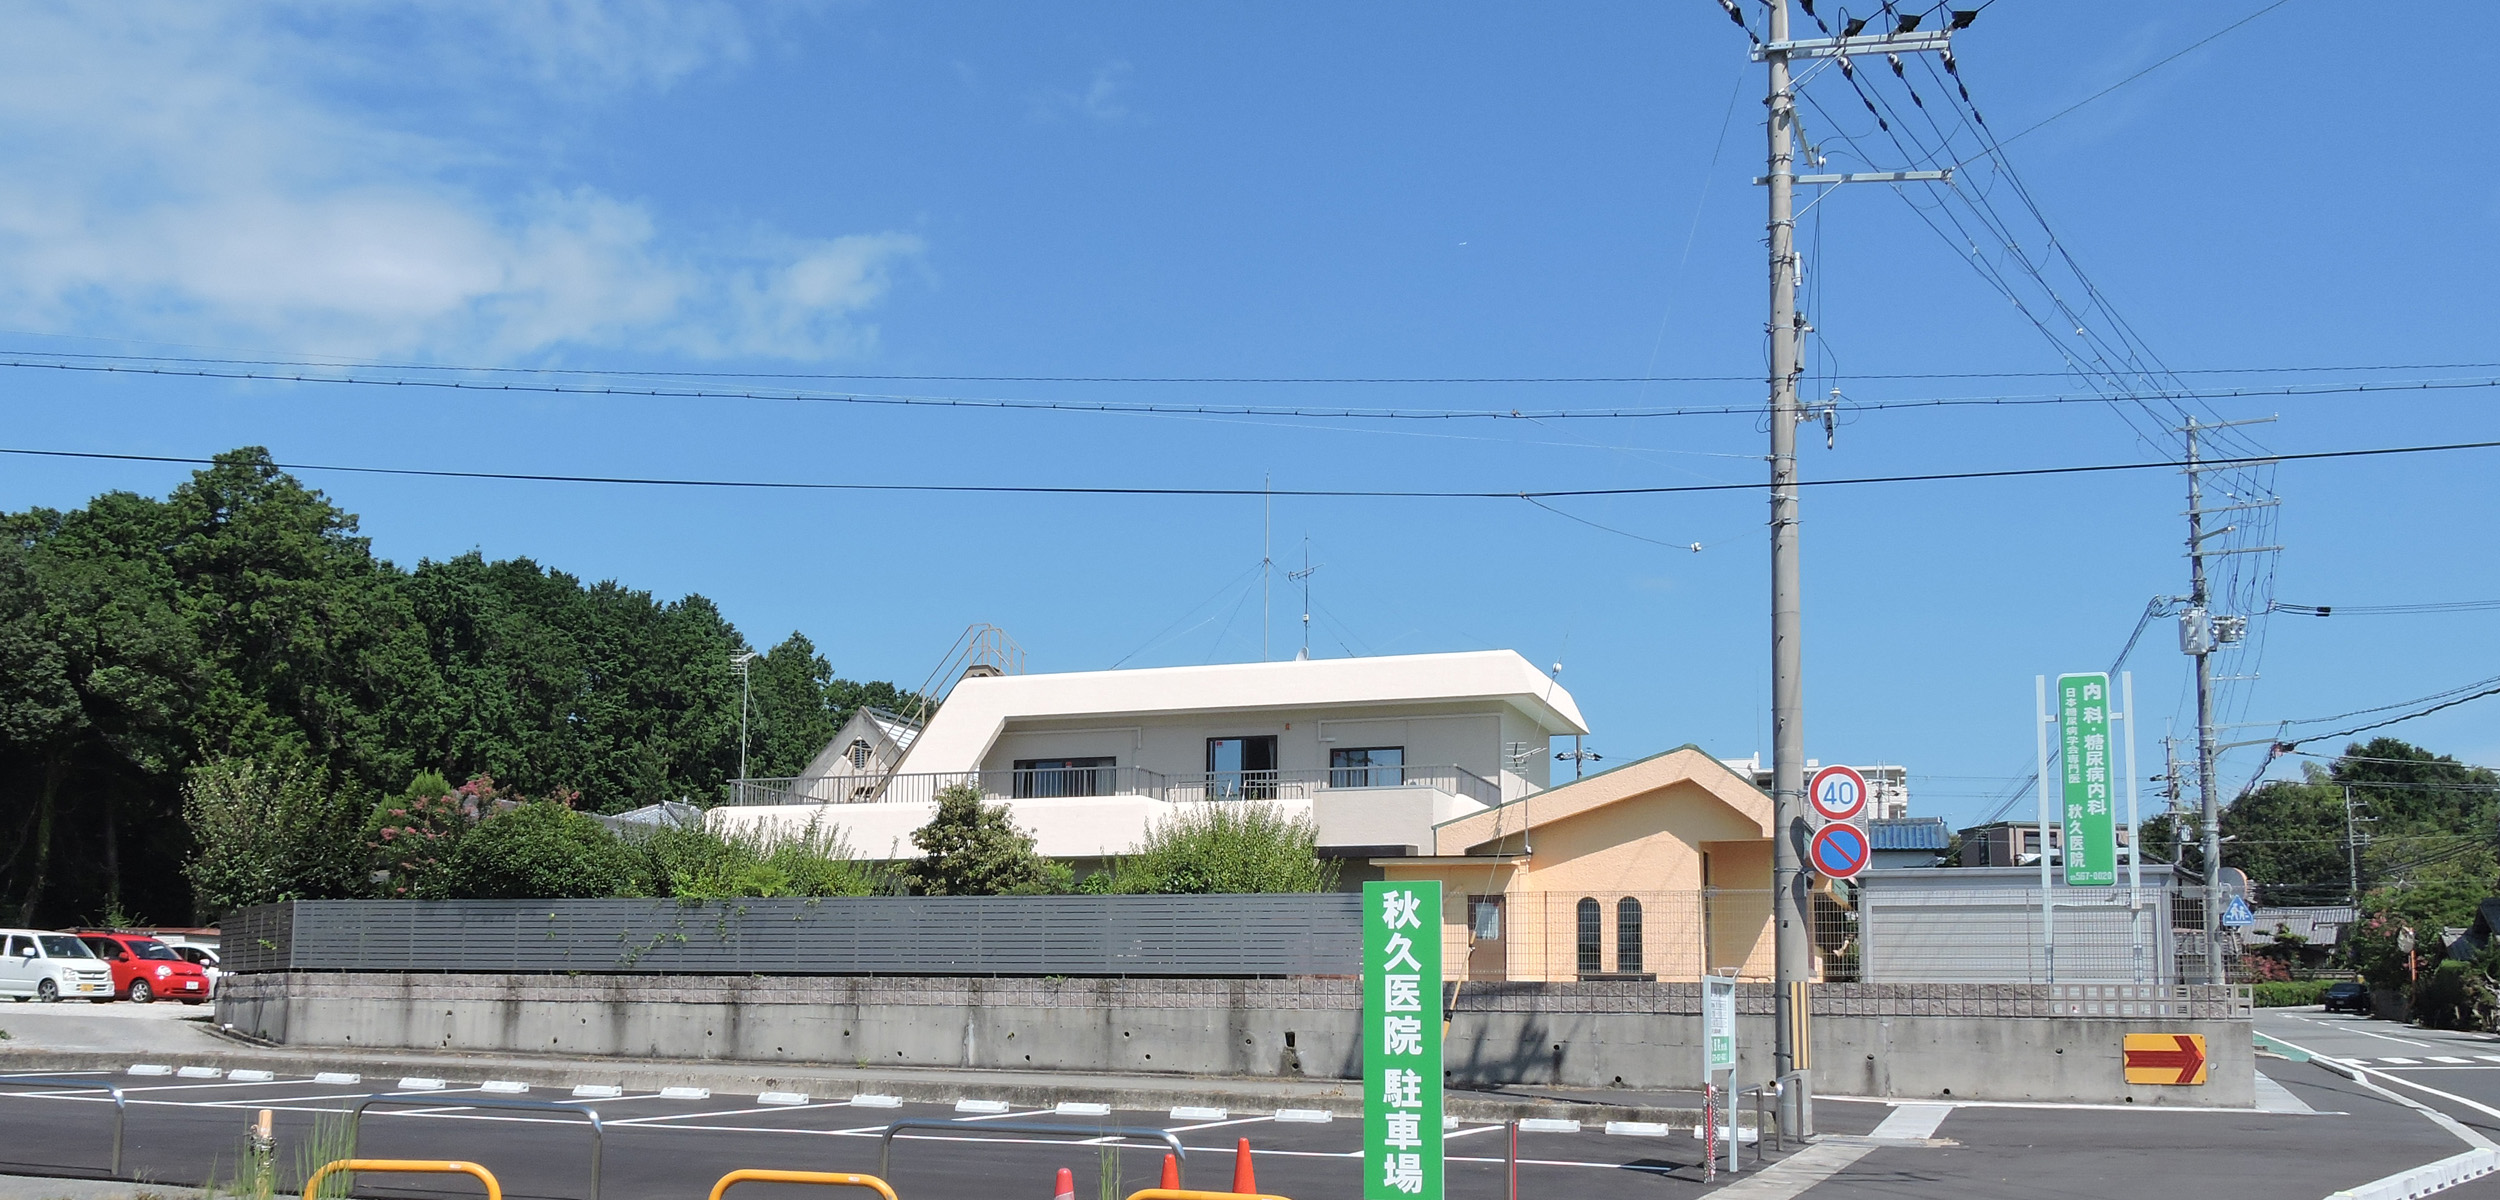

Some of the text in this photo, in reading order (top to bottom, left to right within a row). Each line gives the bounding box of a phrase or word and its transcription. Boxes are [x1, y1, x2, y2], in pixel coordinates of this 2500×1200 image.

[1823, 781, 1854, 805] 40
[2083, 683, 2107, 815] 内科・糖尿病内科
[2068, 804, 2085, 867] 秋久医院
[1382, 890, 1422, 1194] 秋久医院 駐車場
